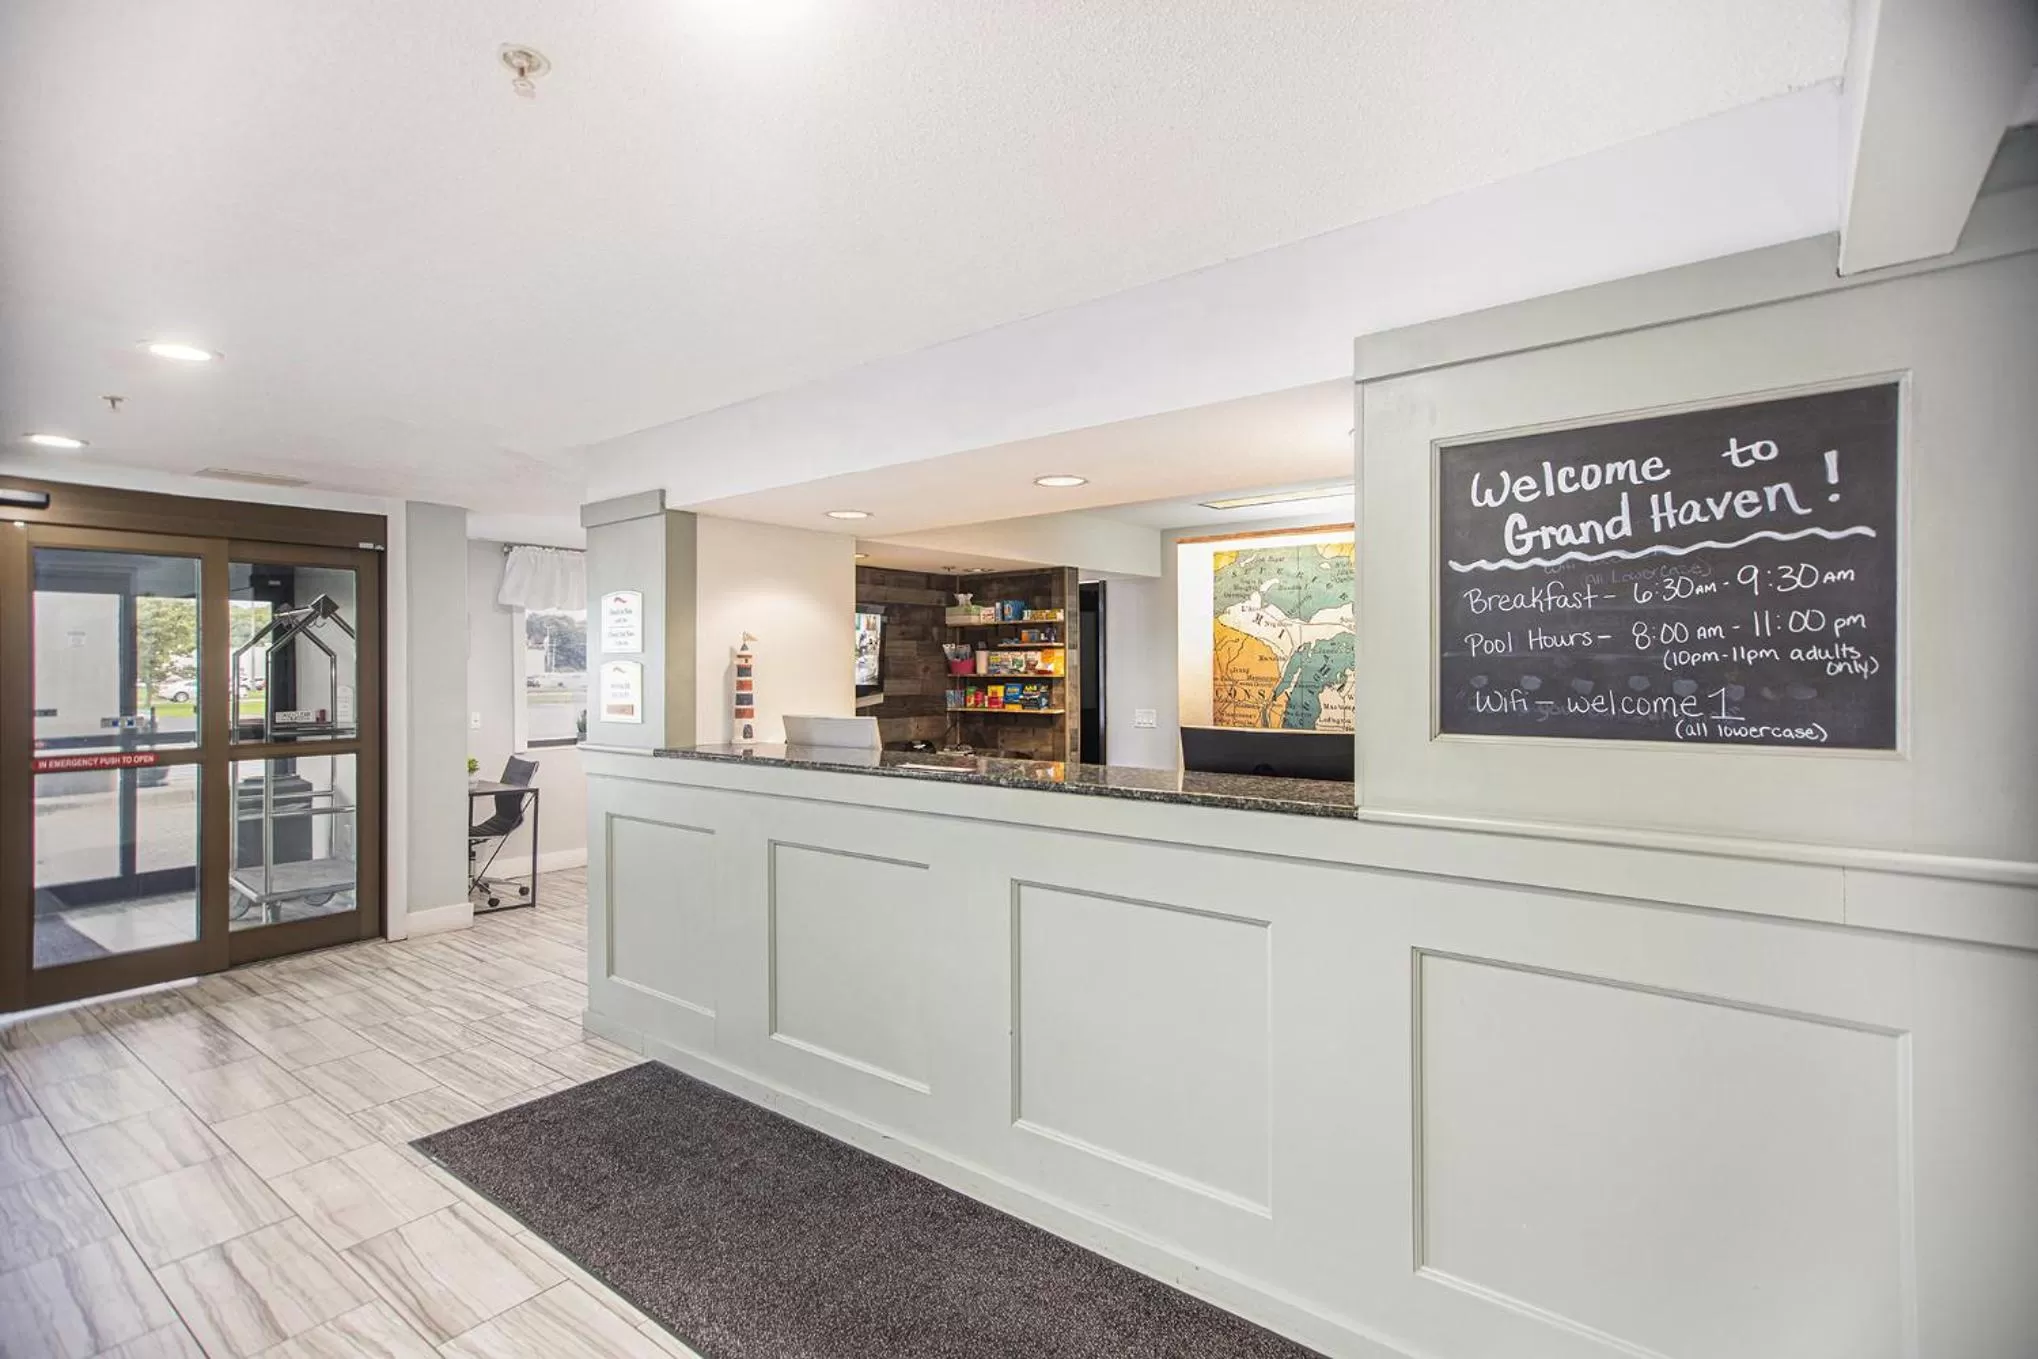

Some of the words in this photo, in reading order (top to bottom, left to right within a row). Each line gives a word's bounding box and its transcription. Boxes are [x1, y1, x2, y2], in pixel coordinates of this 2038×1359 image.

[1470, 456, 1672, 508] Welcome
[1721, 437, 1780, 468] to
[1503, 491, 1633, 557] Grand
[1463, 631, 1513, 658] Pool
[1631, 620, 1690, 650] 8:00
[1753, 609, 1826, 637] 11:00
[1833, 613, 1867, 638] pm
[1789, 643, 1862, 661] adults
[1675, 719, 1708, 740] (all
[1717, 722, 1828, 743] lowercase)
[38, 759, 47, 769] IN
[48, 758, 99, 769] EMERGENCY
[122, 755, 132, 764] TO
[133, 755, 154, 764] OPEN
